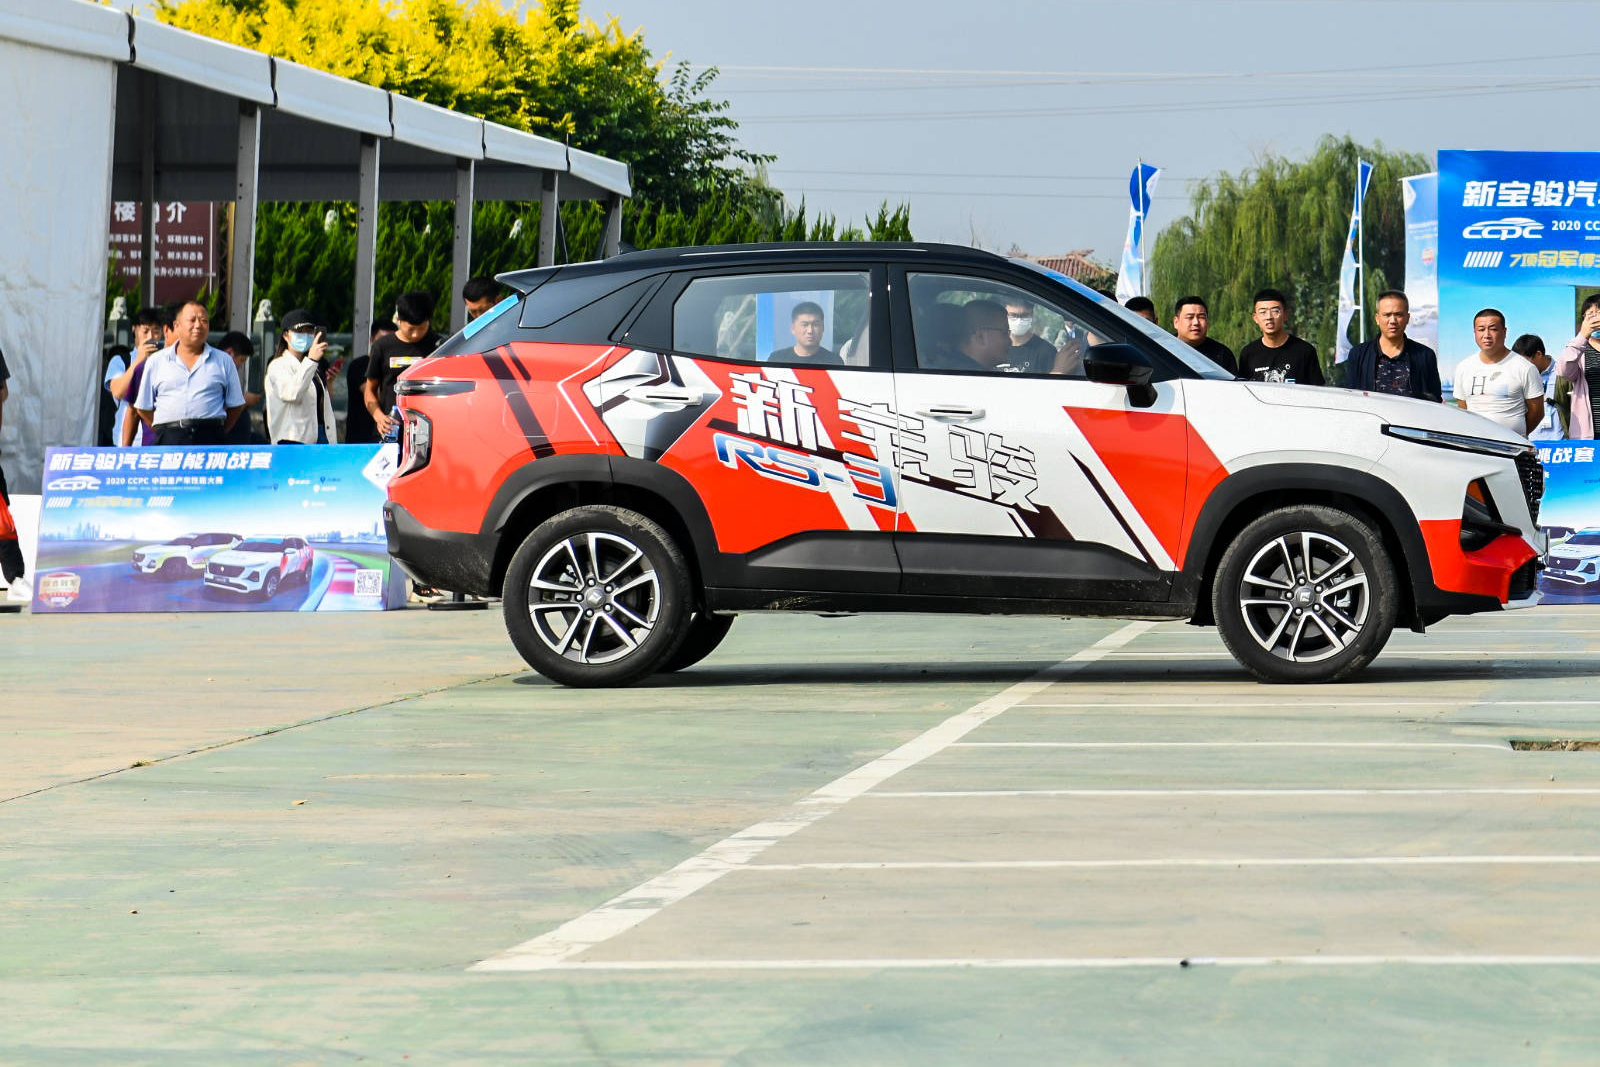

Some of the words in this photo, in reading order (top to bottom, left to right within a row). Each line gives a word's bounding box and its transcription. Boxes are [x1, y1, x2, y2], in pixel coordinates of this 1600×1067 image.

[114, 201, 188, 224] 楼介
[1551, 220, 1581, 232] 2020
[729, 371, 1040, 513] 新宝骏
[49, 452, 273, 471] 新宝骏汽车智能挑战赛
[714, 433, 905, 513] RS-3
